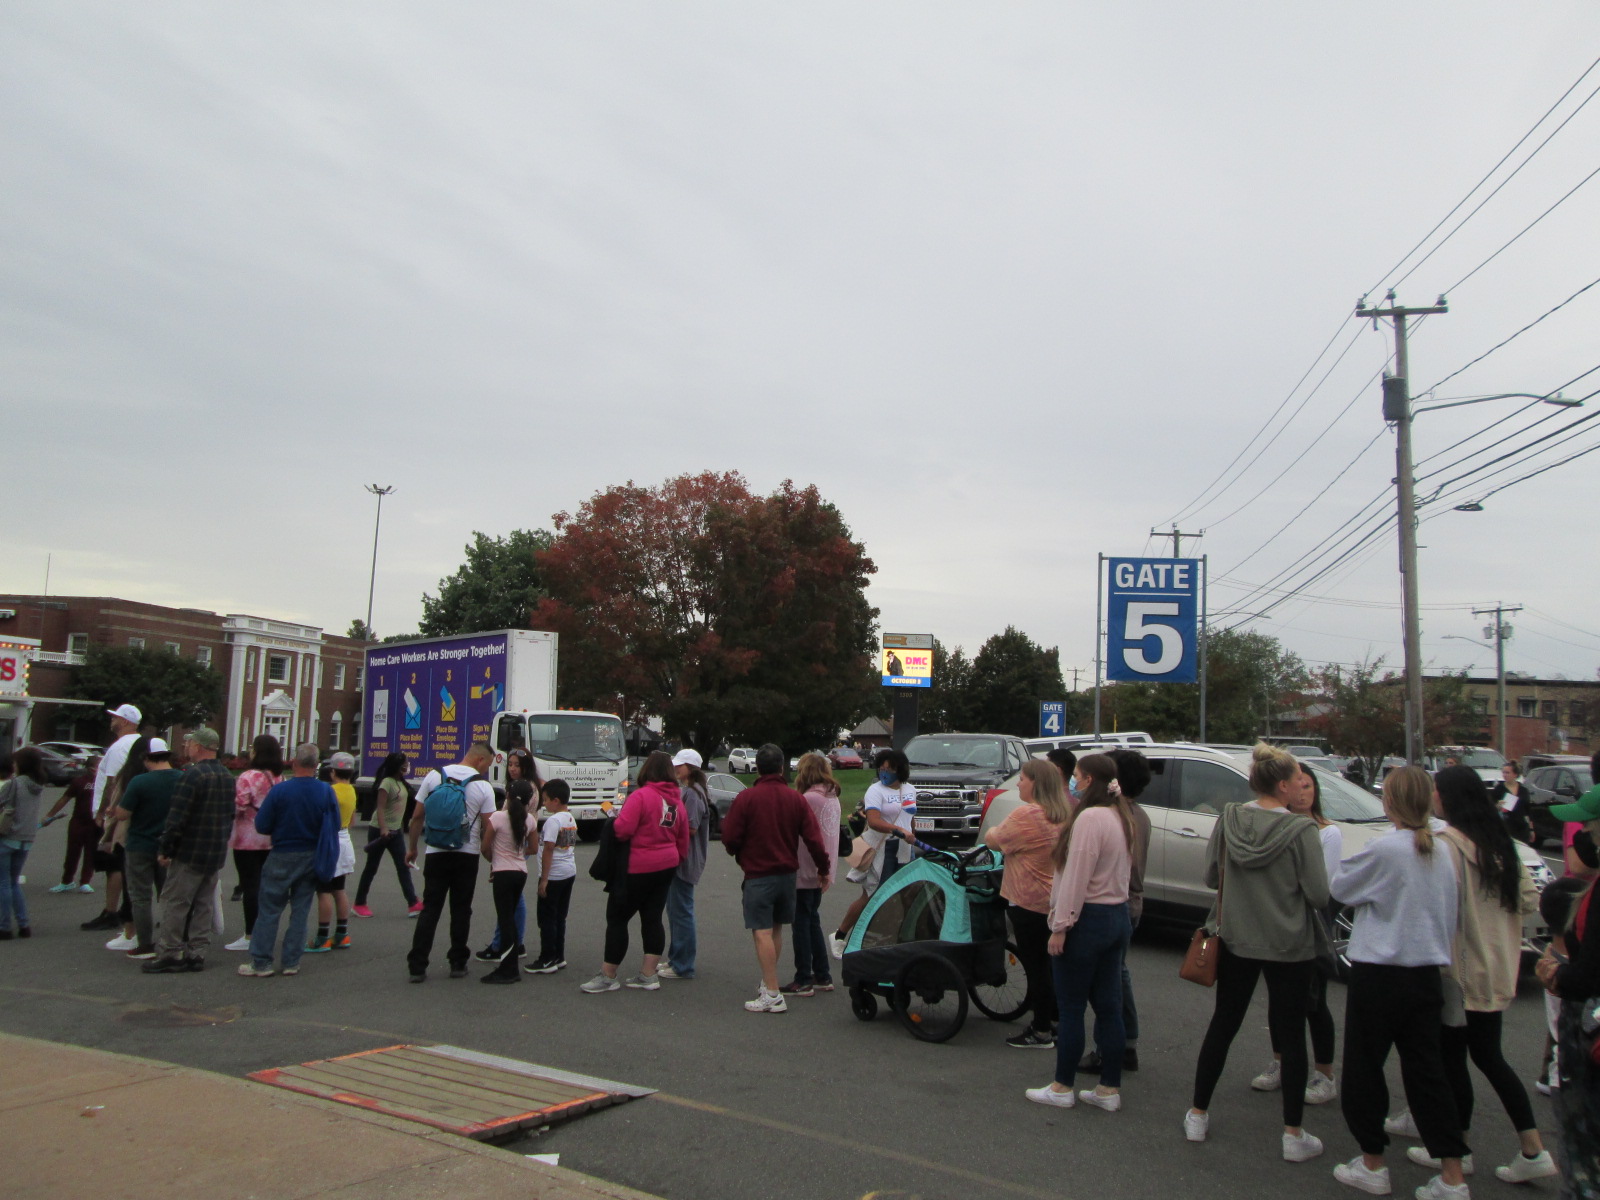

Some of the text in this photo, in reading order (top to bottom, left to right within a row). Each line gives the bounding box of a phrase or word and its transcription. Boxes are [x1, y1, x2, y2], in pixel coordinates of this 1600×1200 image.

[1115, 563, 1190, 589] GATE
[1123, 602, 1184, 675] 5
[370, 643, 505, 667] Home Care Workers Are Stronger Together!
[905, 657, 928, 665] DMC
[411, 672, 417, 684] 2
[446, 669, 452, 682] 3
[484, 666, 491, 679] 4
[380, 675, 384, 687] 1
[891, 677, 917, 685] OCTOBER
[1043, 703, 1063, 712] GATE
[473, 724, 484, 733] Sign
[1045, 713, 1060, 733] 4
[436, 734, 456, 742] Envelope
[472, 733, 489, 741] Envelo
[435, 751, 456, 760] Envelope
